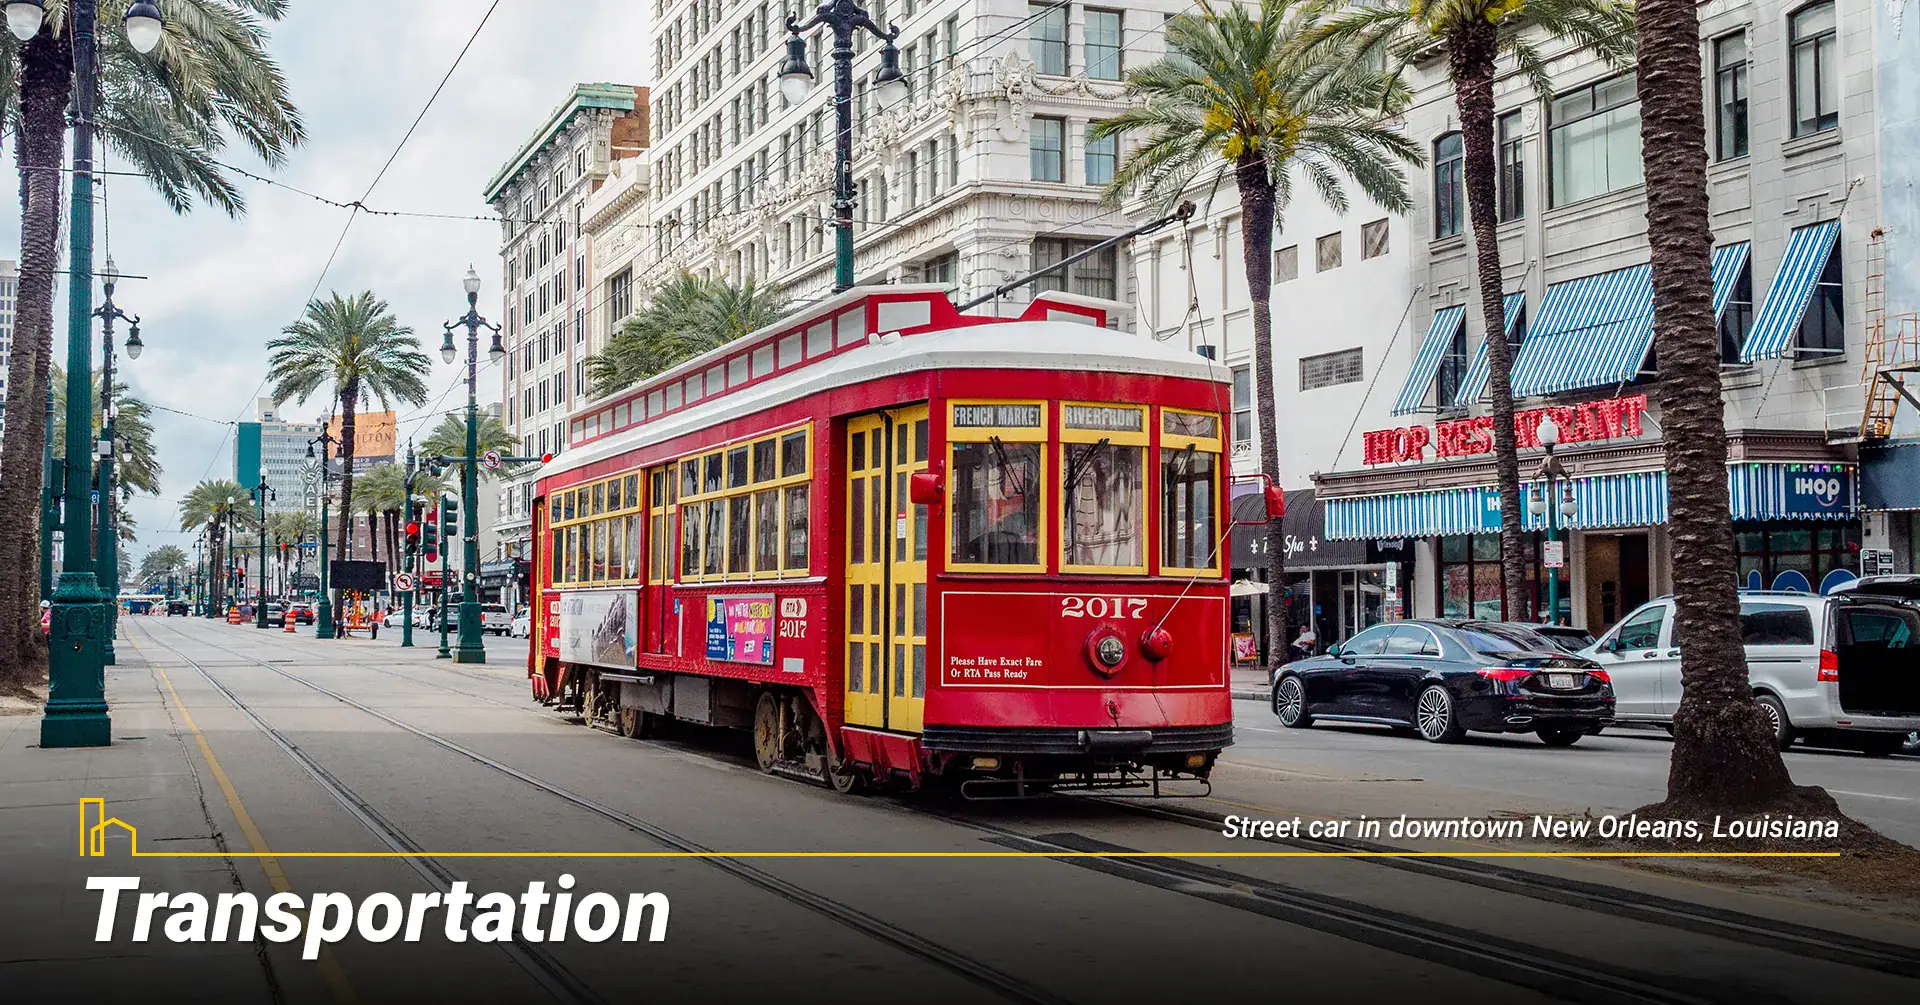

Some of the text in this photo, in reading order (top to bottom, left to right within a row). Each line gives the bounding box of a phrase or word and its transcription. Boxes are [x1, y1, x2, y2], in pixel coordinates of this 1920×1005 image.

[954, 406, 1040, 426] FRENCH MARKET
[1065, 406, 1141, 427] RIVERFRONT
[1363, 394, 1648, 466] IHOP RESAURANT
[1795, 477, 1840, 501] IHOP
[1283, 535, 1304, 559] Spa
[1061, 596, 1148, 619] 2017
[779, 619, 807, 638] 2017
[950, 656, 1043, 666] Please Have Exact Fare
[950, 668, 1028, 680] Or RTA Pass Ready
